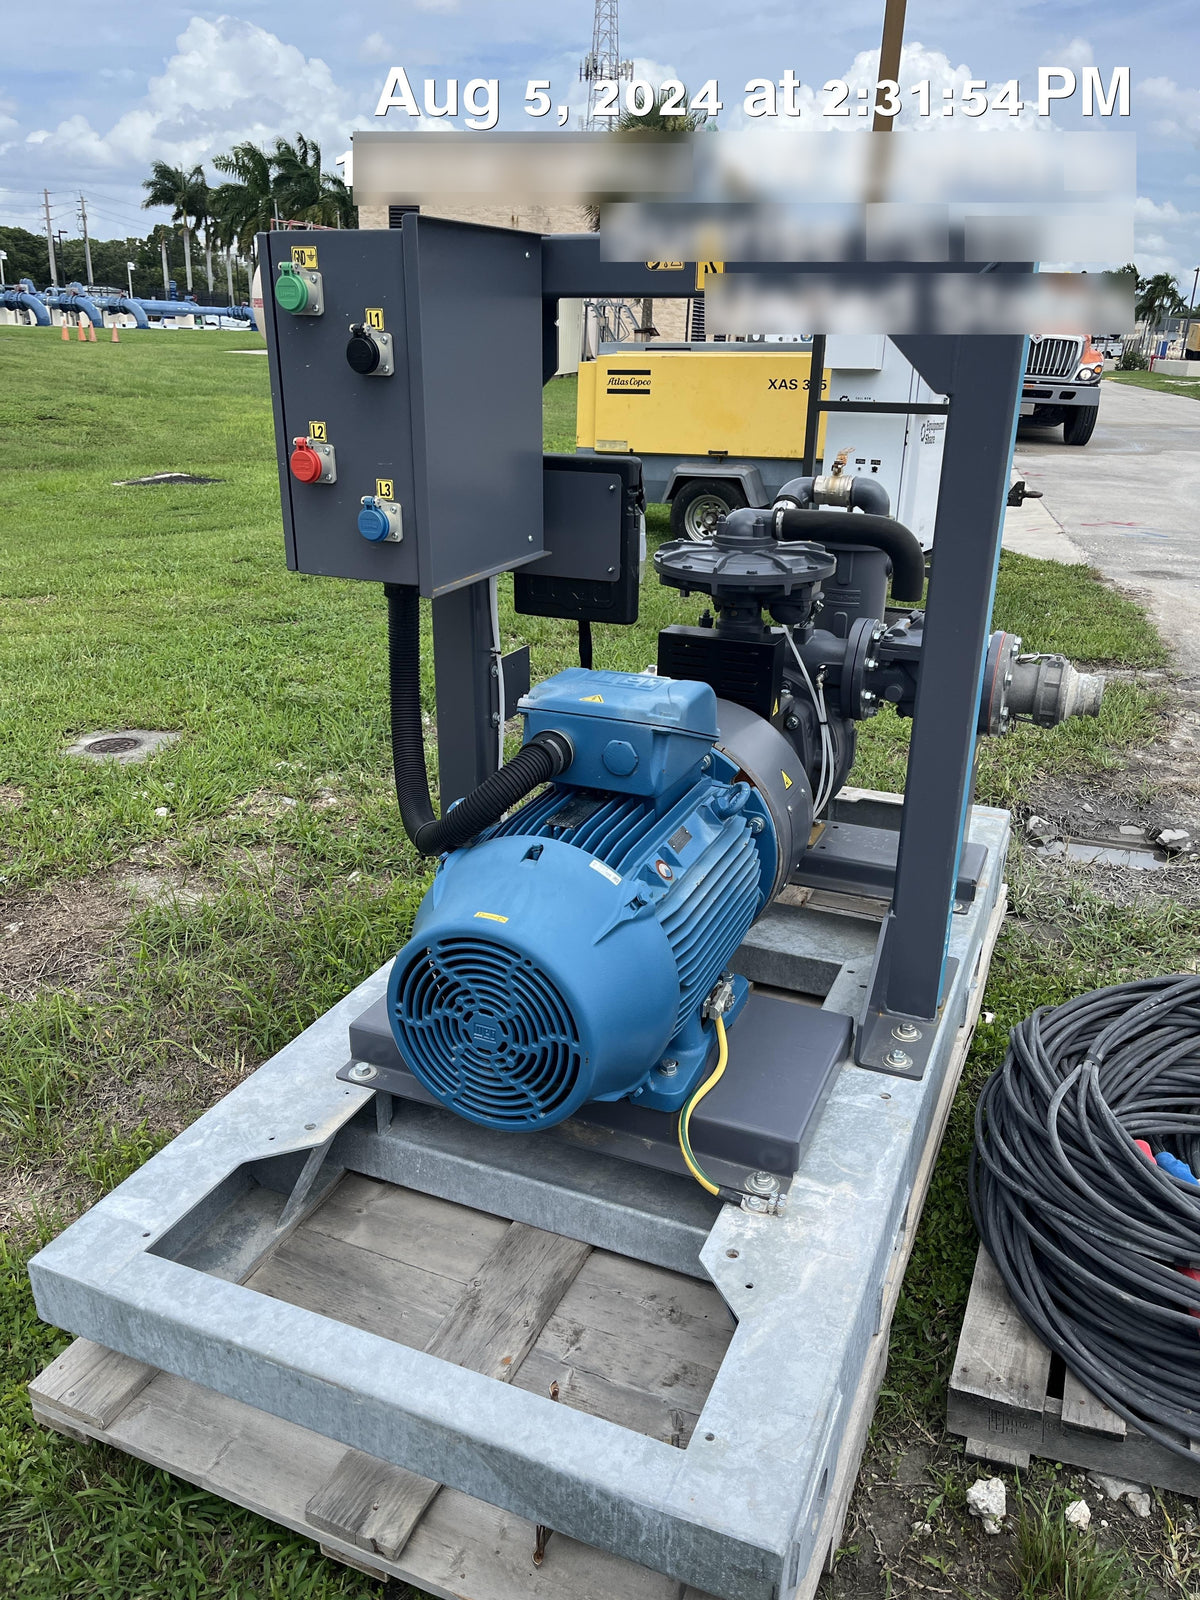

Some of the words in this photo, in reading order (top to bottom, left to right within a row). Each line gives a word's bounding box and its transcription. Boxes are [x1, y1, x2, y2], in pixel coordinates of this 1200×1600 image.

[369, 311, 380, 328] L1
[607, 377, 629, 386] Atlas
[629, 376, 652, 387] Copco
[767, 378, 799, 390] XAS
[802, 379, 828, 391] 35
[312, 425, 324, 439] L2
[379, 482, 391, 497] L3
